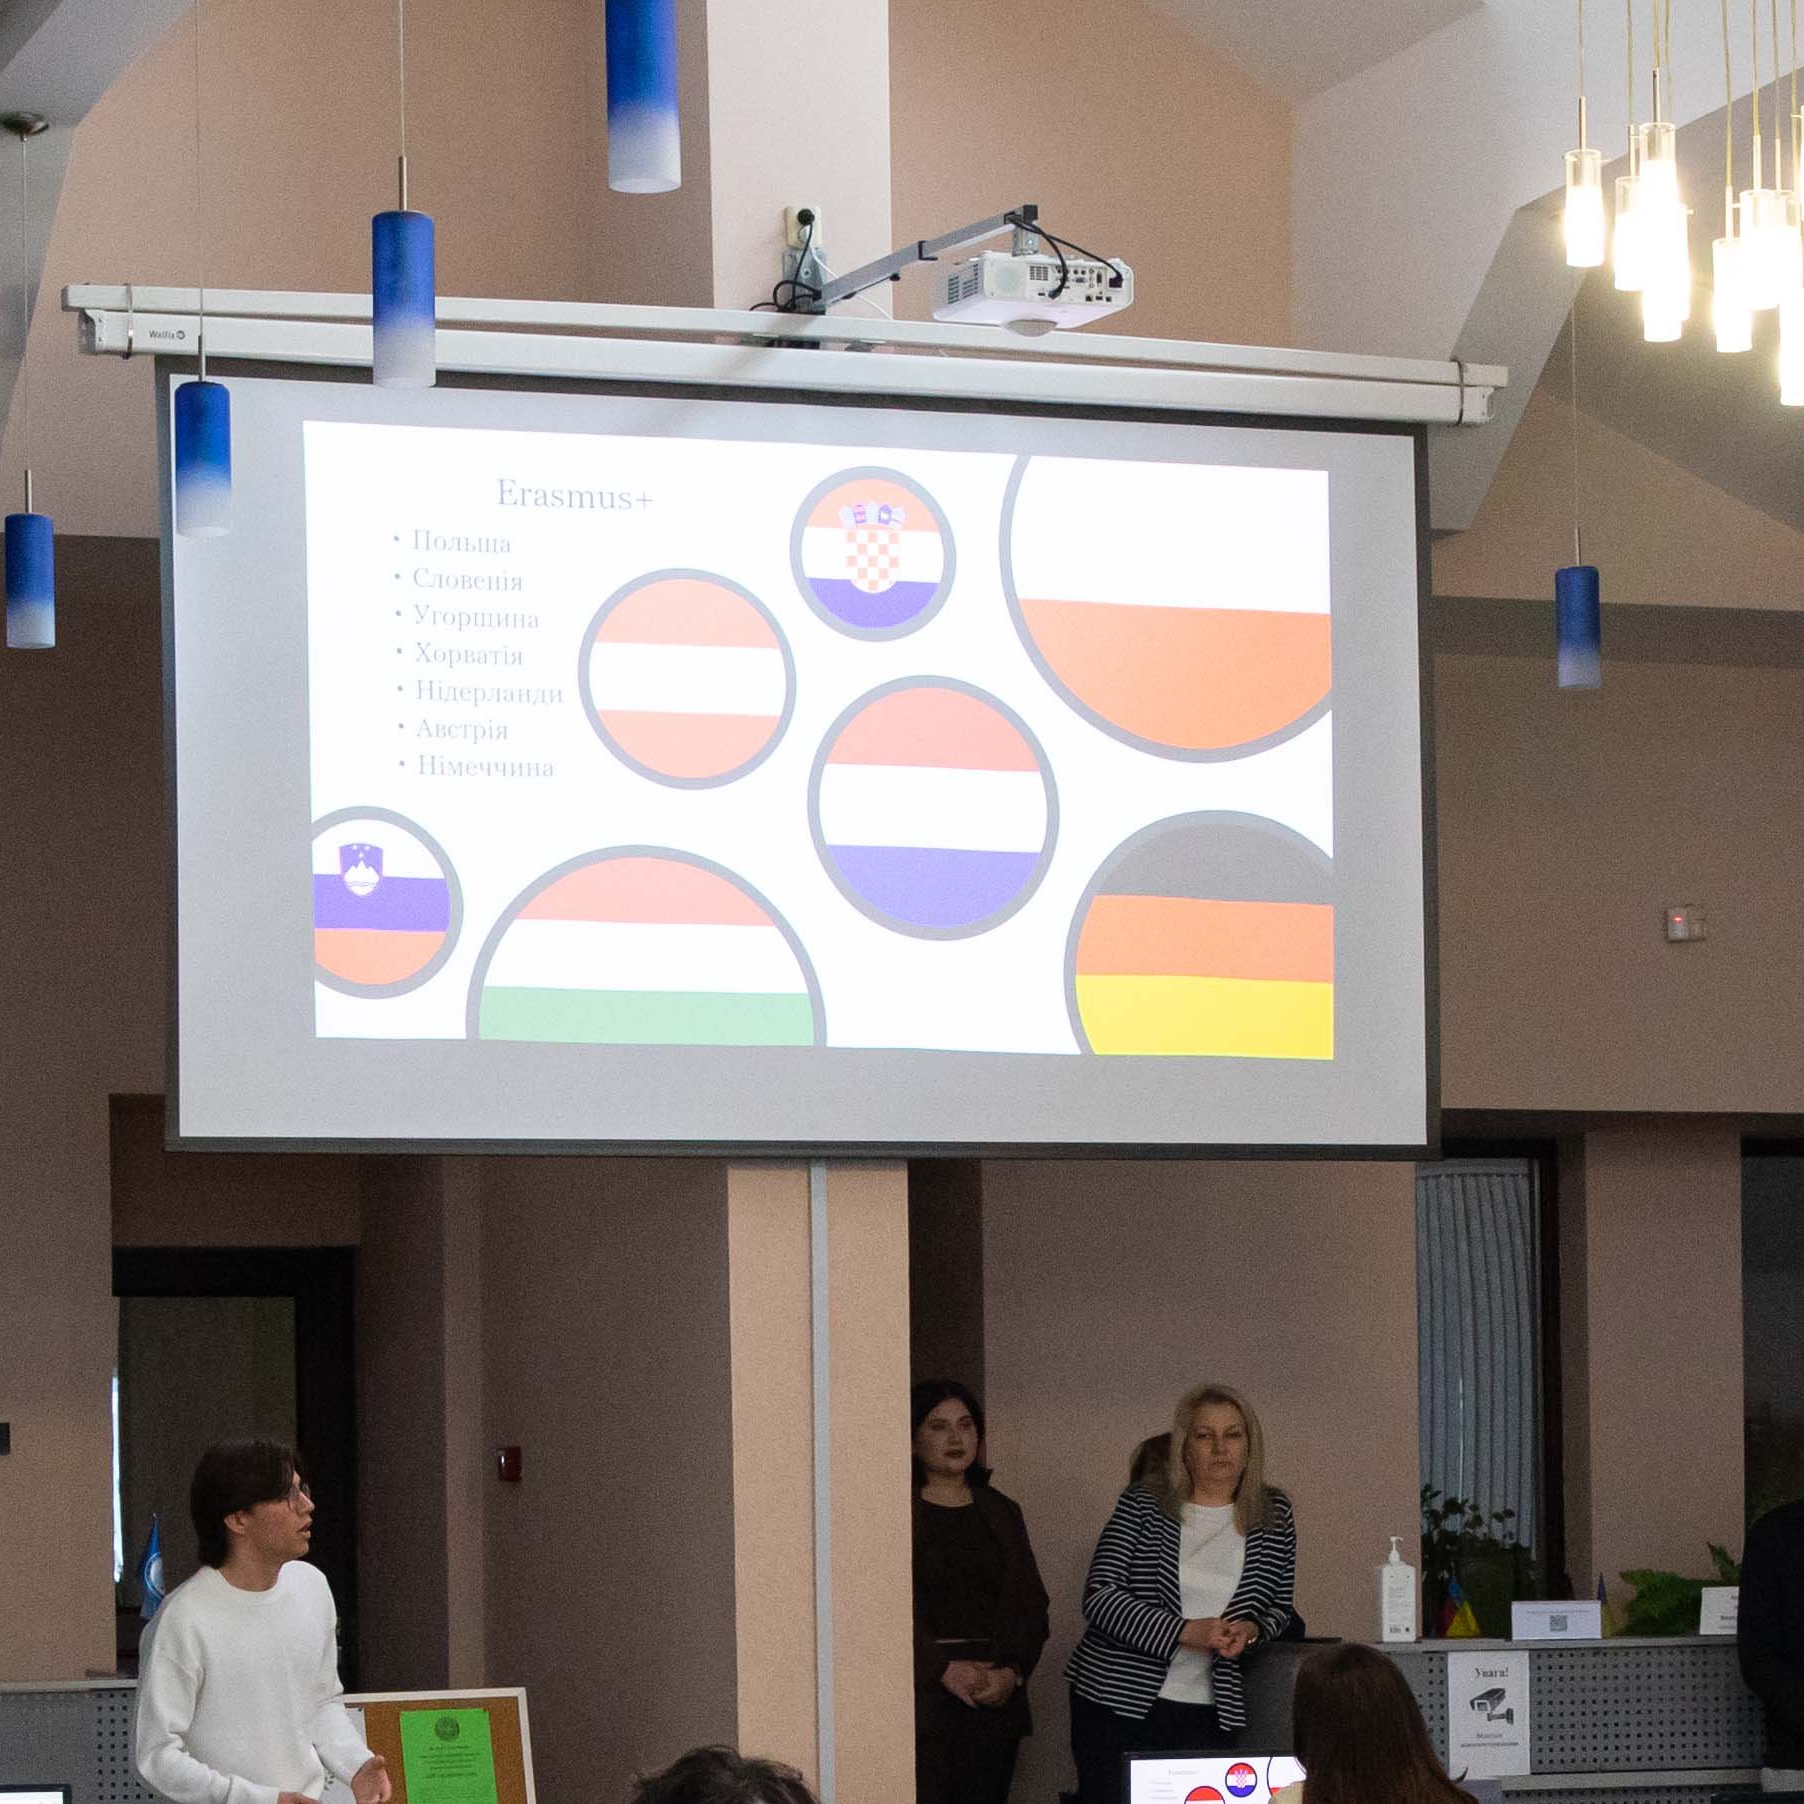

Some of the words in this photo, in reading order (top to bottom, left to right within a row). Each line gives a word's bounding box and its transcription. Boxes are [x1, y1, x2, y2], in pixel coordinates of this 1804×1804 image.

[497, 478, 653, 510] Erasmus+
[412, 528, 511, 555] Польща
[412, 567, 523, 592] Словенія
[412, 603, 539, 631] Угорщина
[415, 642, 523, 669] Хорватія
[416, 679, 563, 707] Нідерланди
[416, 718, 508, 744] Австрія
[418, 754, 554, 777] Німеччина
